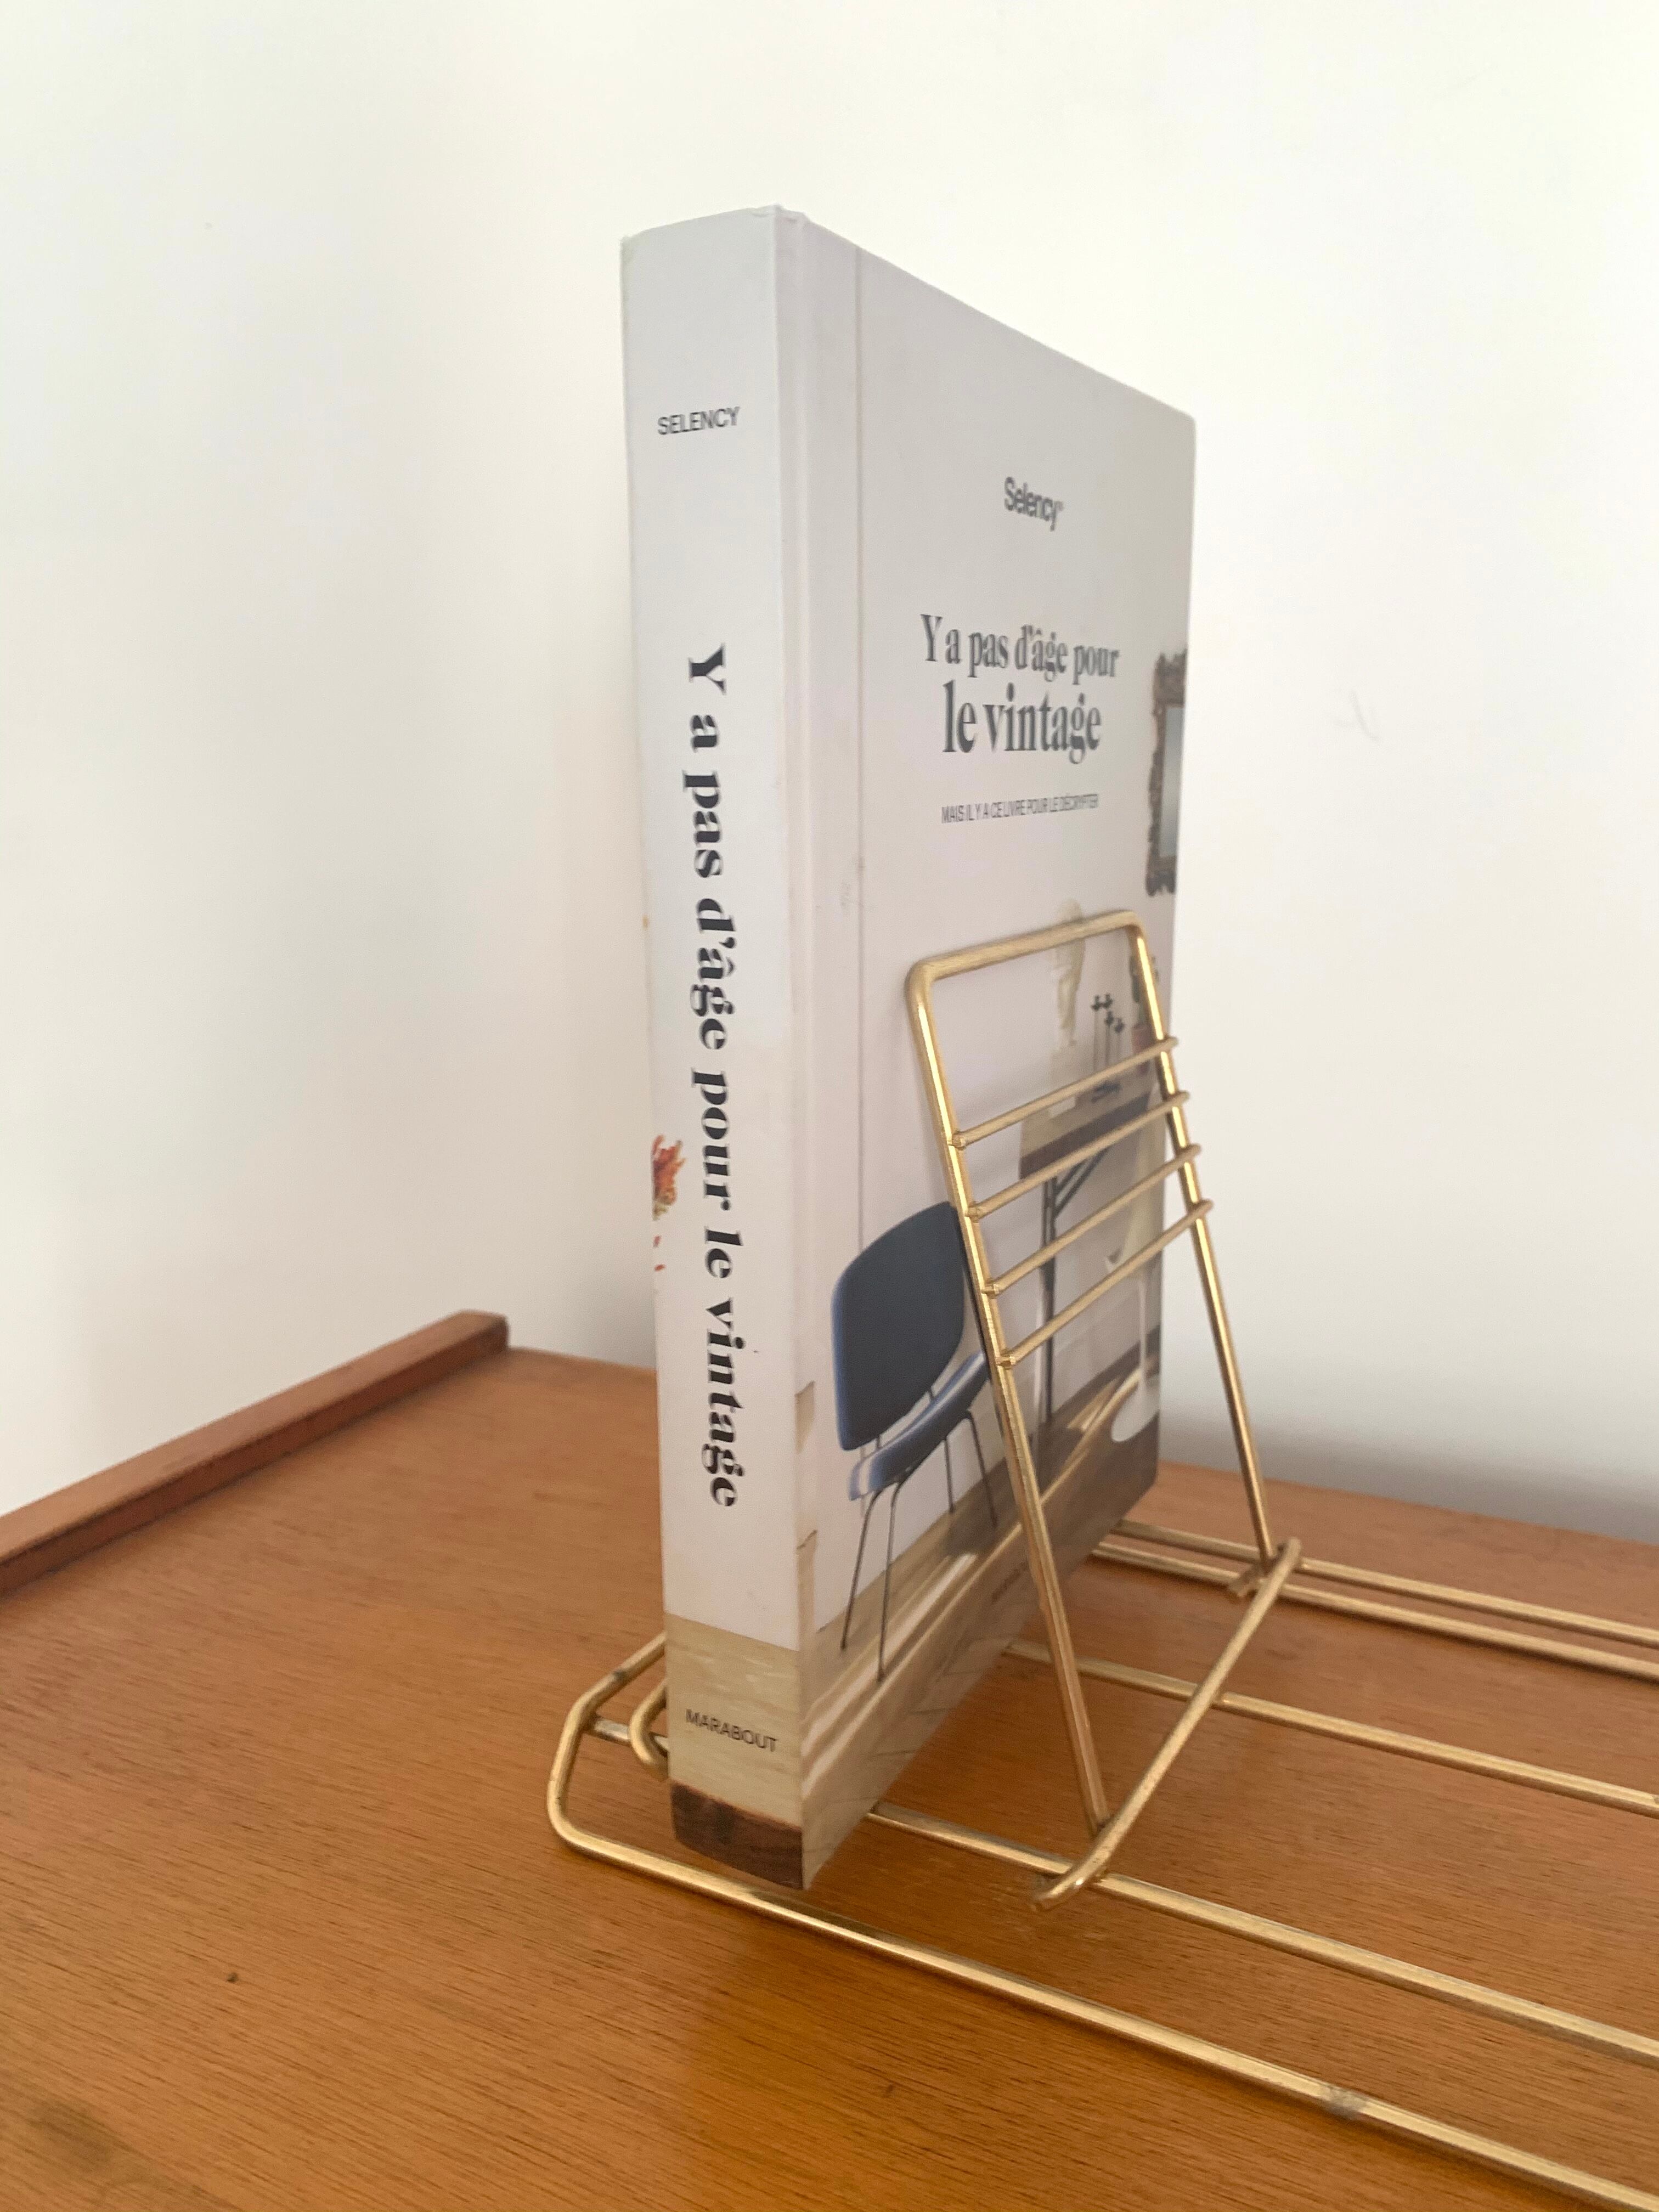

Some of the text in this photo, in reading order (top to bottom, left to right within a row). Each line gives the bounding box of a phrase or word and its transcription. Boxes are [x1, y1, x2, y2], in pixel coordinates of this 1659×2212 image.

[658, 407, 740, 435] SELENCY
[1004, 476, 1062, 532] Selency
[920, 614, 1120, 685] Y a pas d'âge pour
[942, 679, 1101, 764] le vintage
[941, 804, 964, 823] MAIS
[682, 642, 744, 1507] Y a pas d'âge pour le vintage
[686, 1708, 777, 1752] MARABOUT
